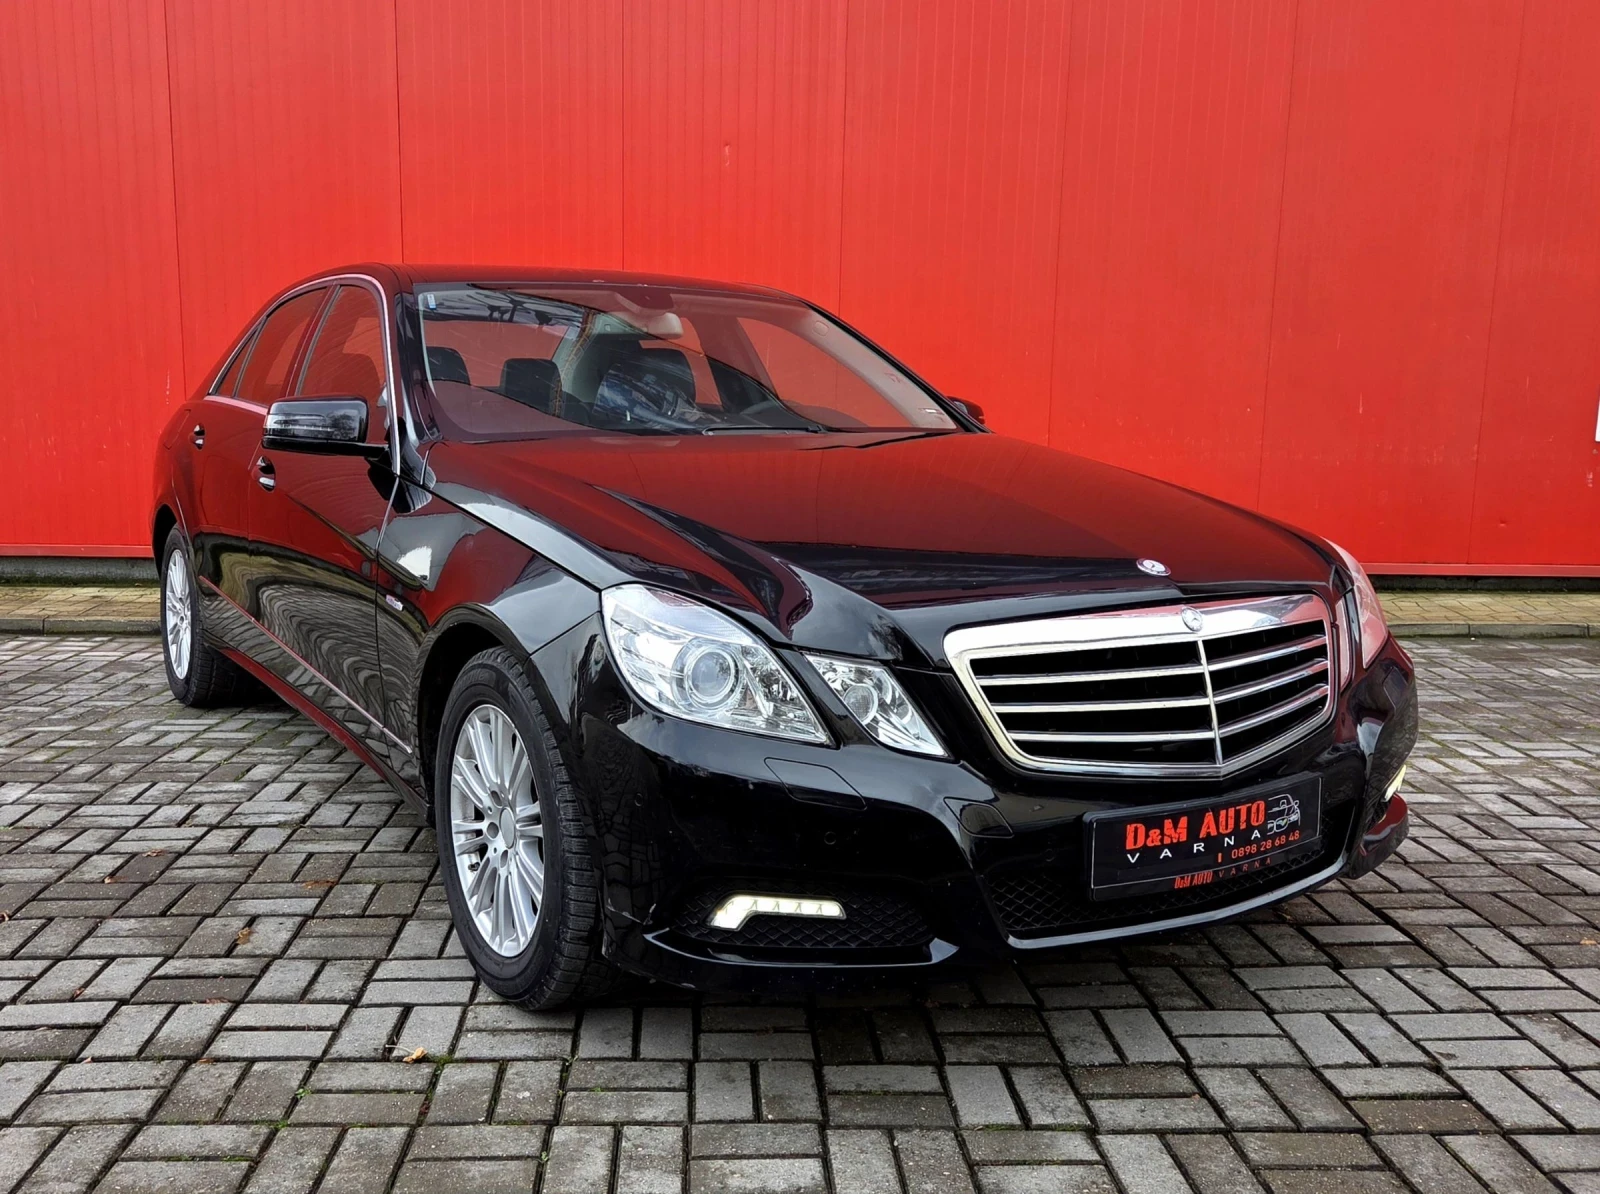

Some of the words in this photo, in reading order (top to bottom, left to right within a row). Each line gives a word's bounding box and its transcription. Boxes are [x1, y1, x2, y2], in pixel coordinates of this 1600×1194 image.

[1125, 815, 1188, 850] D&M
[1199, 800, 1266, 839] AUTO
[1127, 829, 1261, 864] VARNA
[1231, 845, 1257, 859] 0898
[1260, 840, 1273, 851] 28
[1274, 835, 1286, 847] 68
[1288, 829, 1301, 842] 48
[1192, 871, 1214, 887] AUTO
[1219, 857, 1272, 879] VARNA
